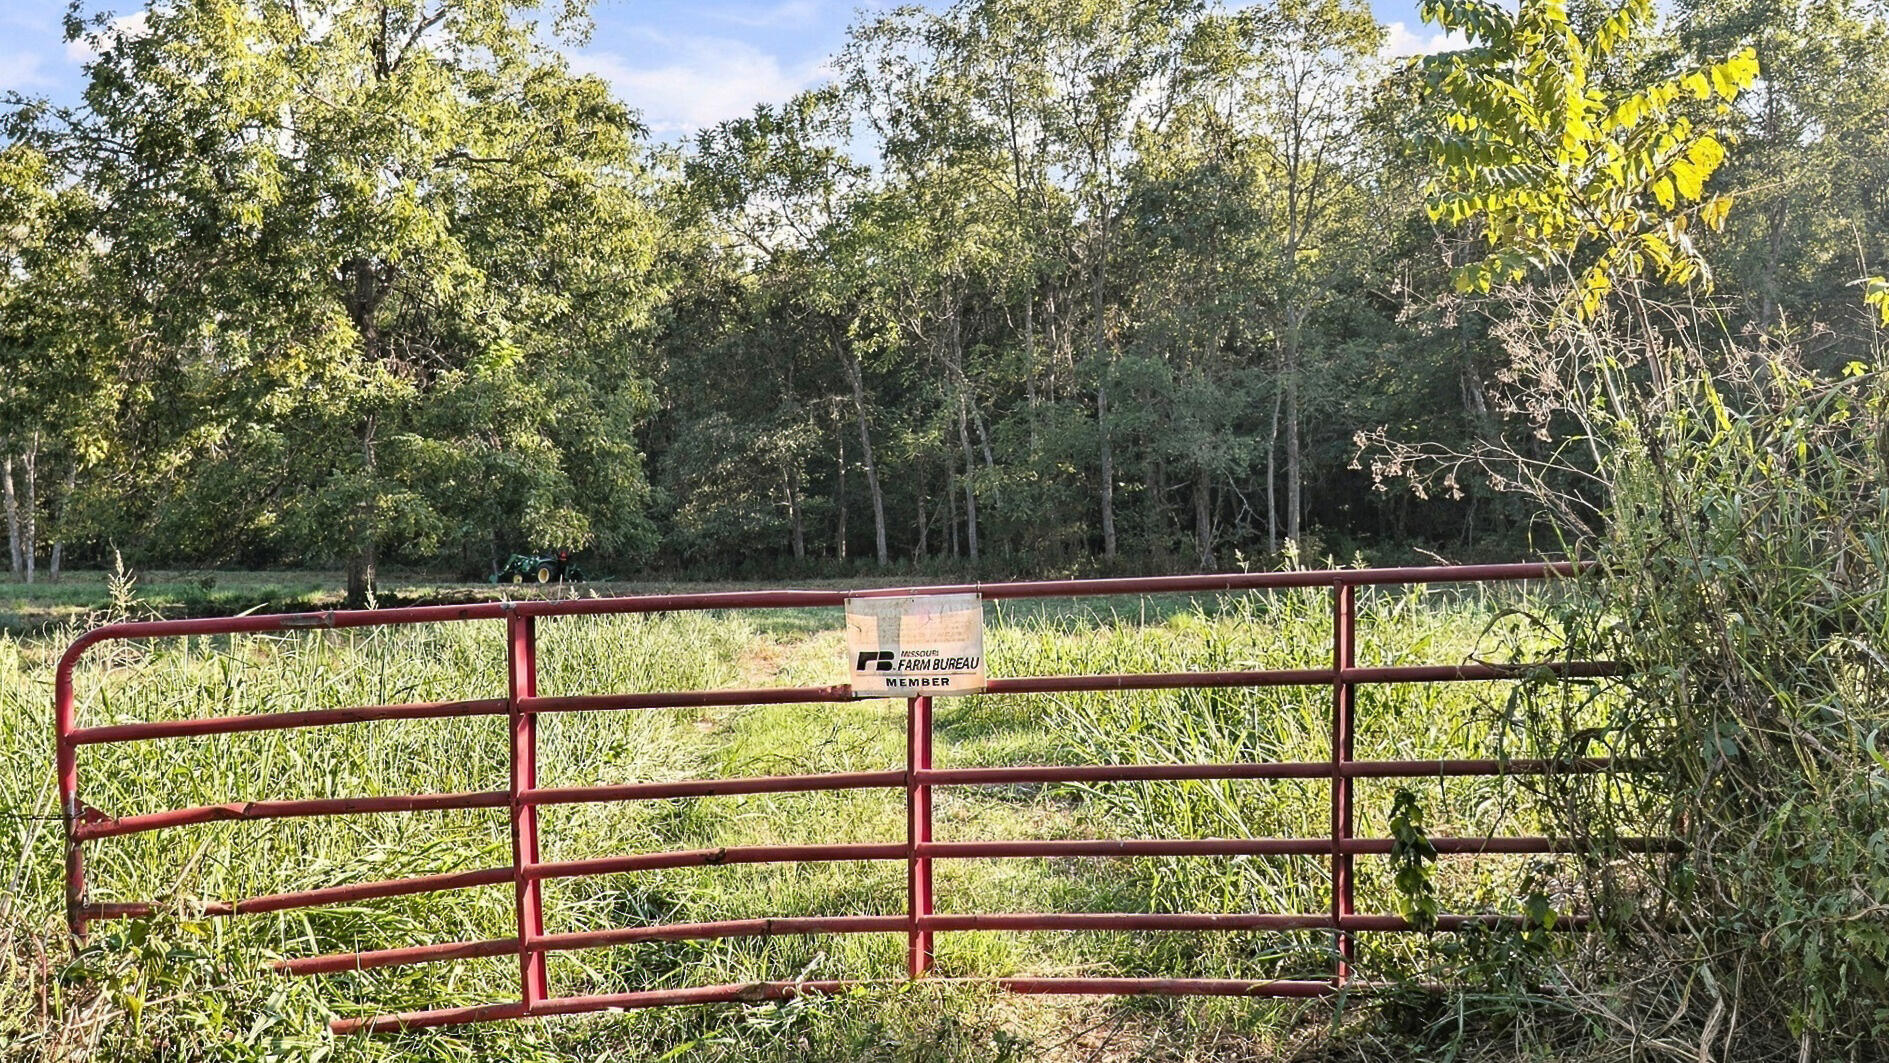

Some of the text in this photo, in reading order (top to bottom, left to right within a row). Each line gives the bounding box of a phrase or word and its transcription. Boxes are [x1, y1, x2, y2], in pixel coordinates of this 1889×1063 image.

[898, 657, 980, 671] FARM BUREAU
[886, 678, 950, 687] MEMBER
